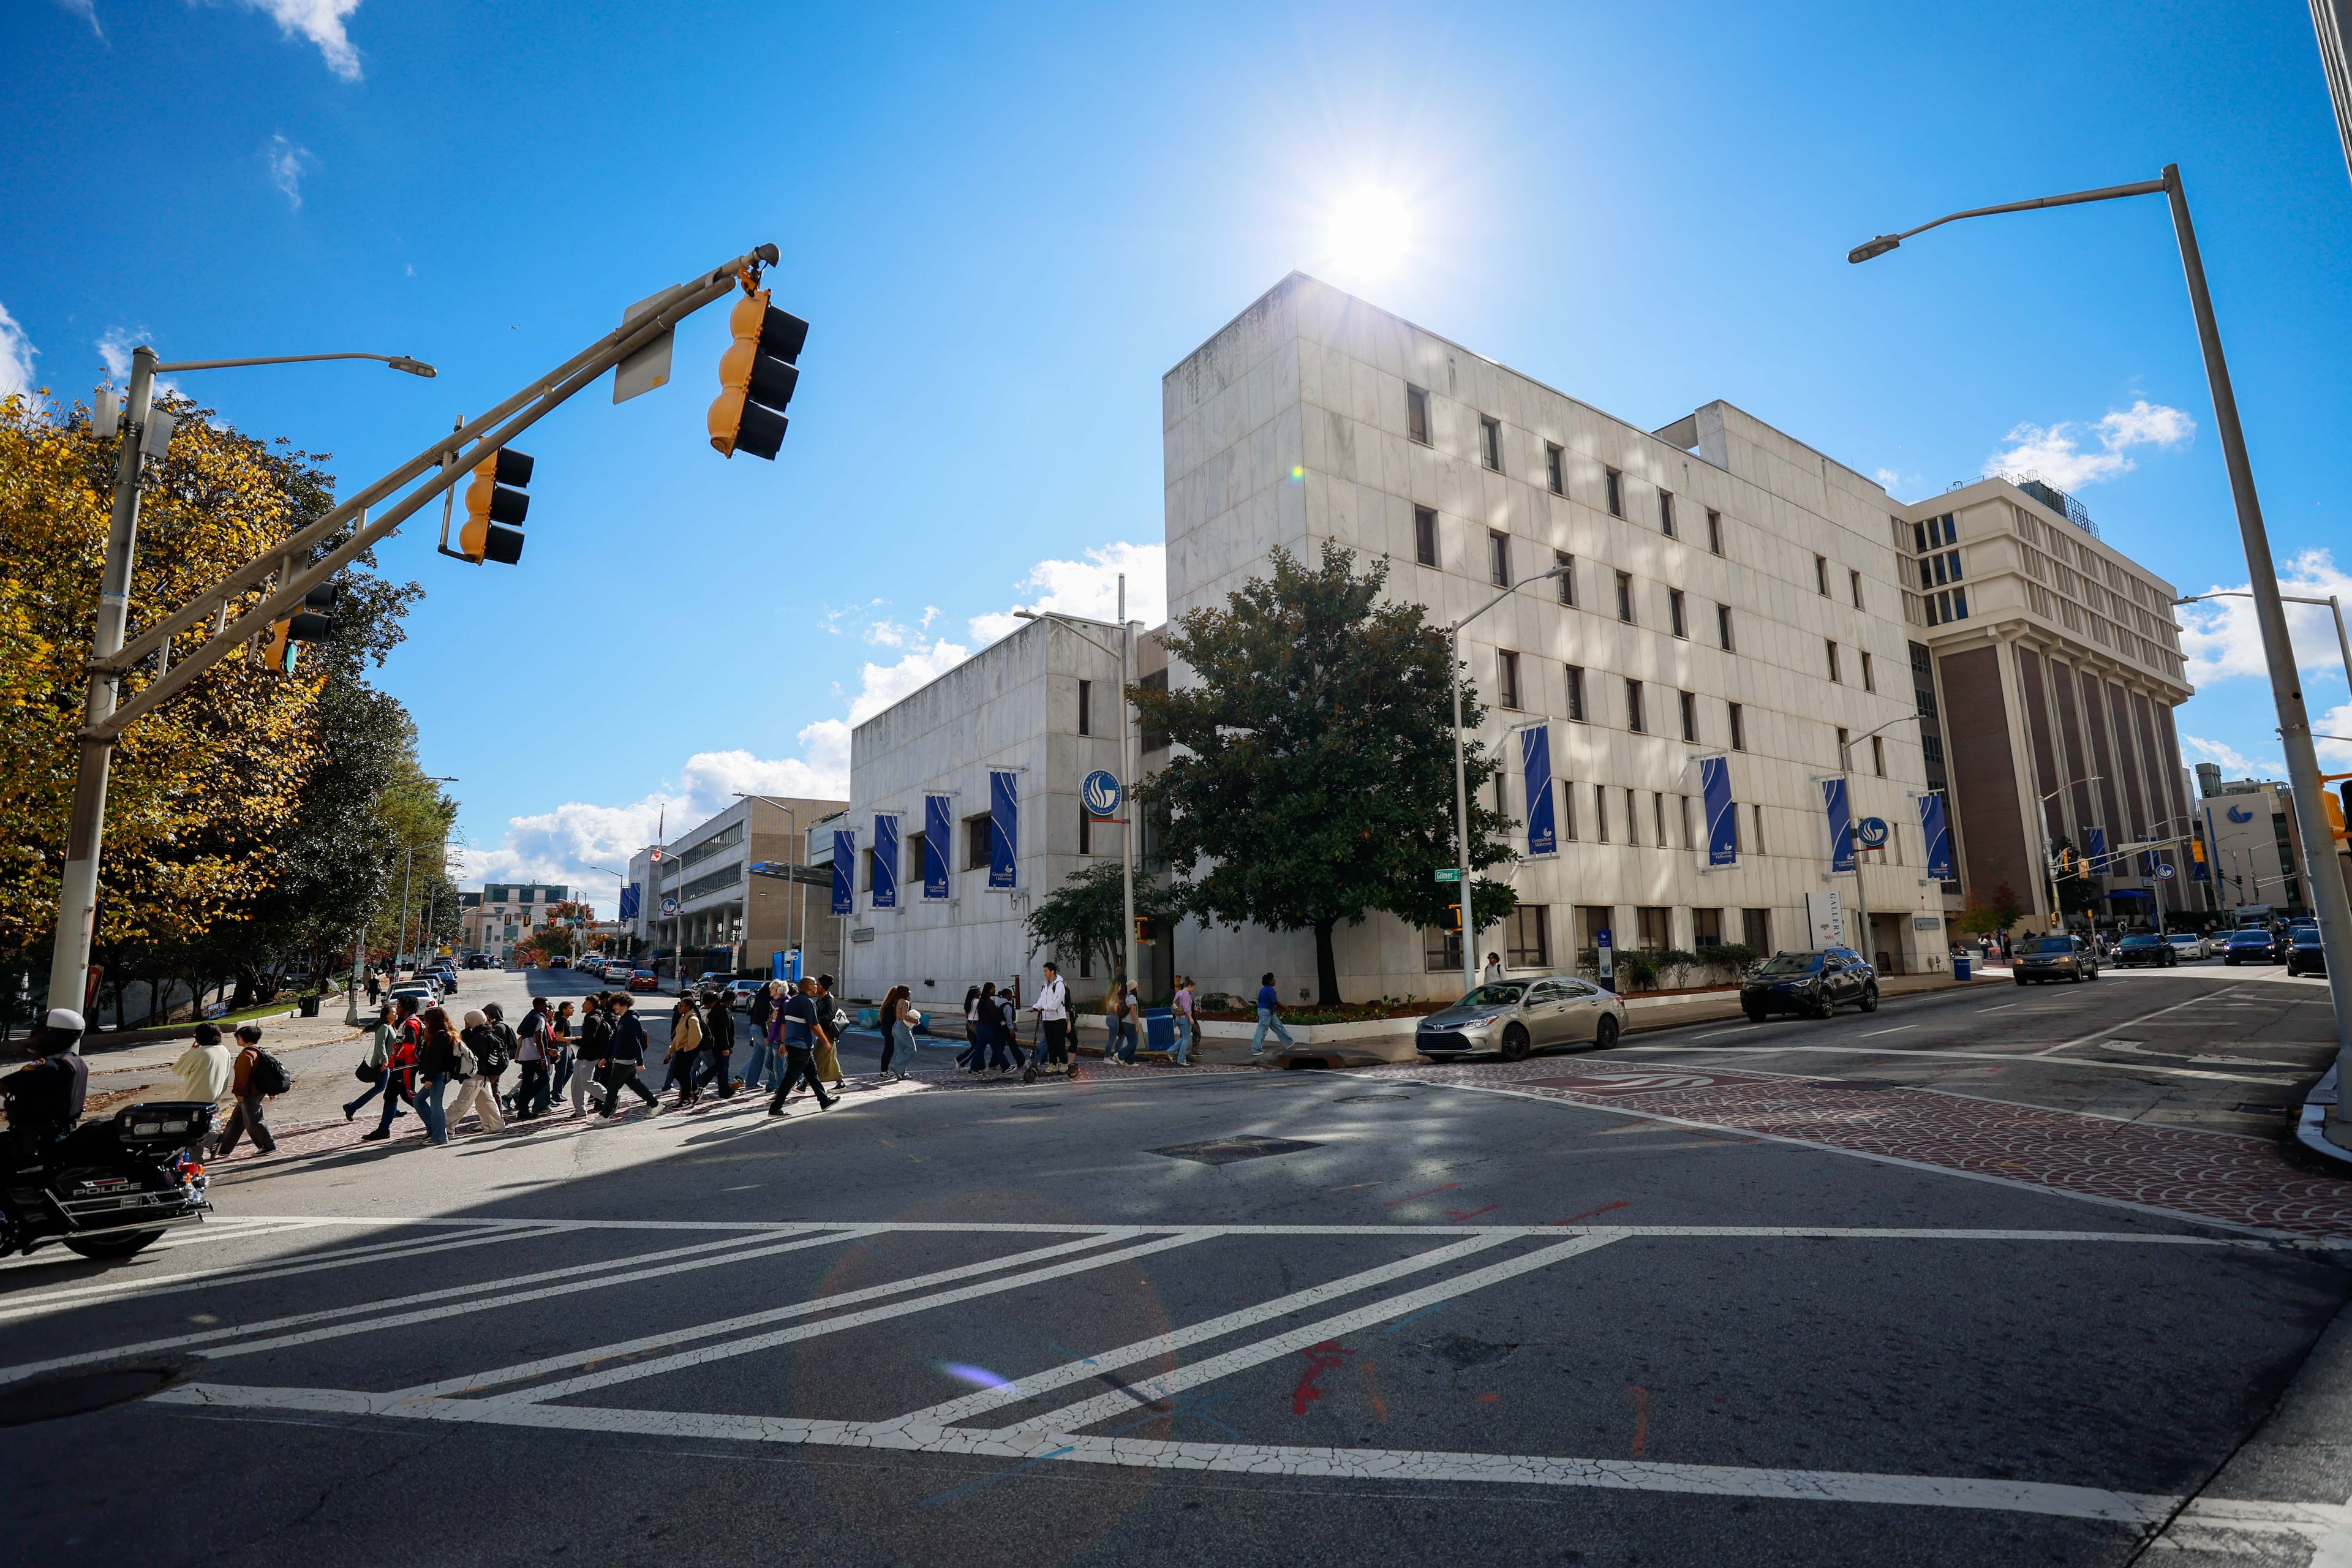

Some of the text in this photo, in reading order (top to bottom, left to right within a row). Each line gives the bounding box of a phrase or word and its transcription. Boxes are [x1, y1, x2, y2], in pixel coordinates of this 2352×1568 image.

[1107, 774, 1120, 806] UNIVERSITY
[1830, 893, 1841, 937] GALLERY
[73, 1182, 141, 1196] POLICE
